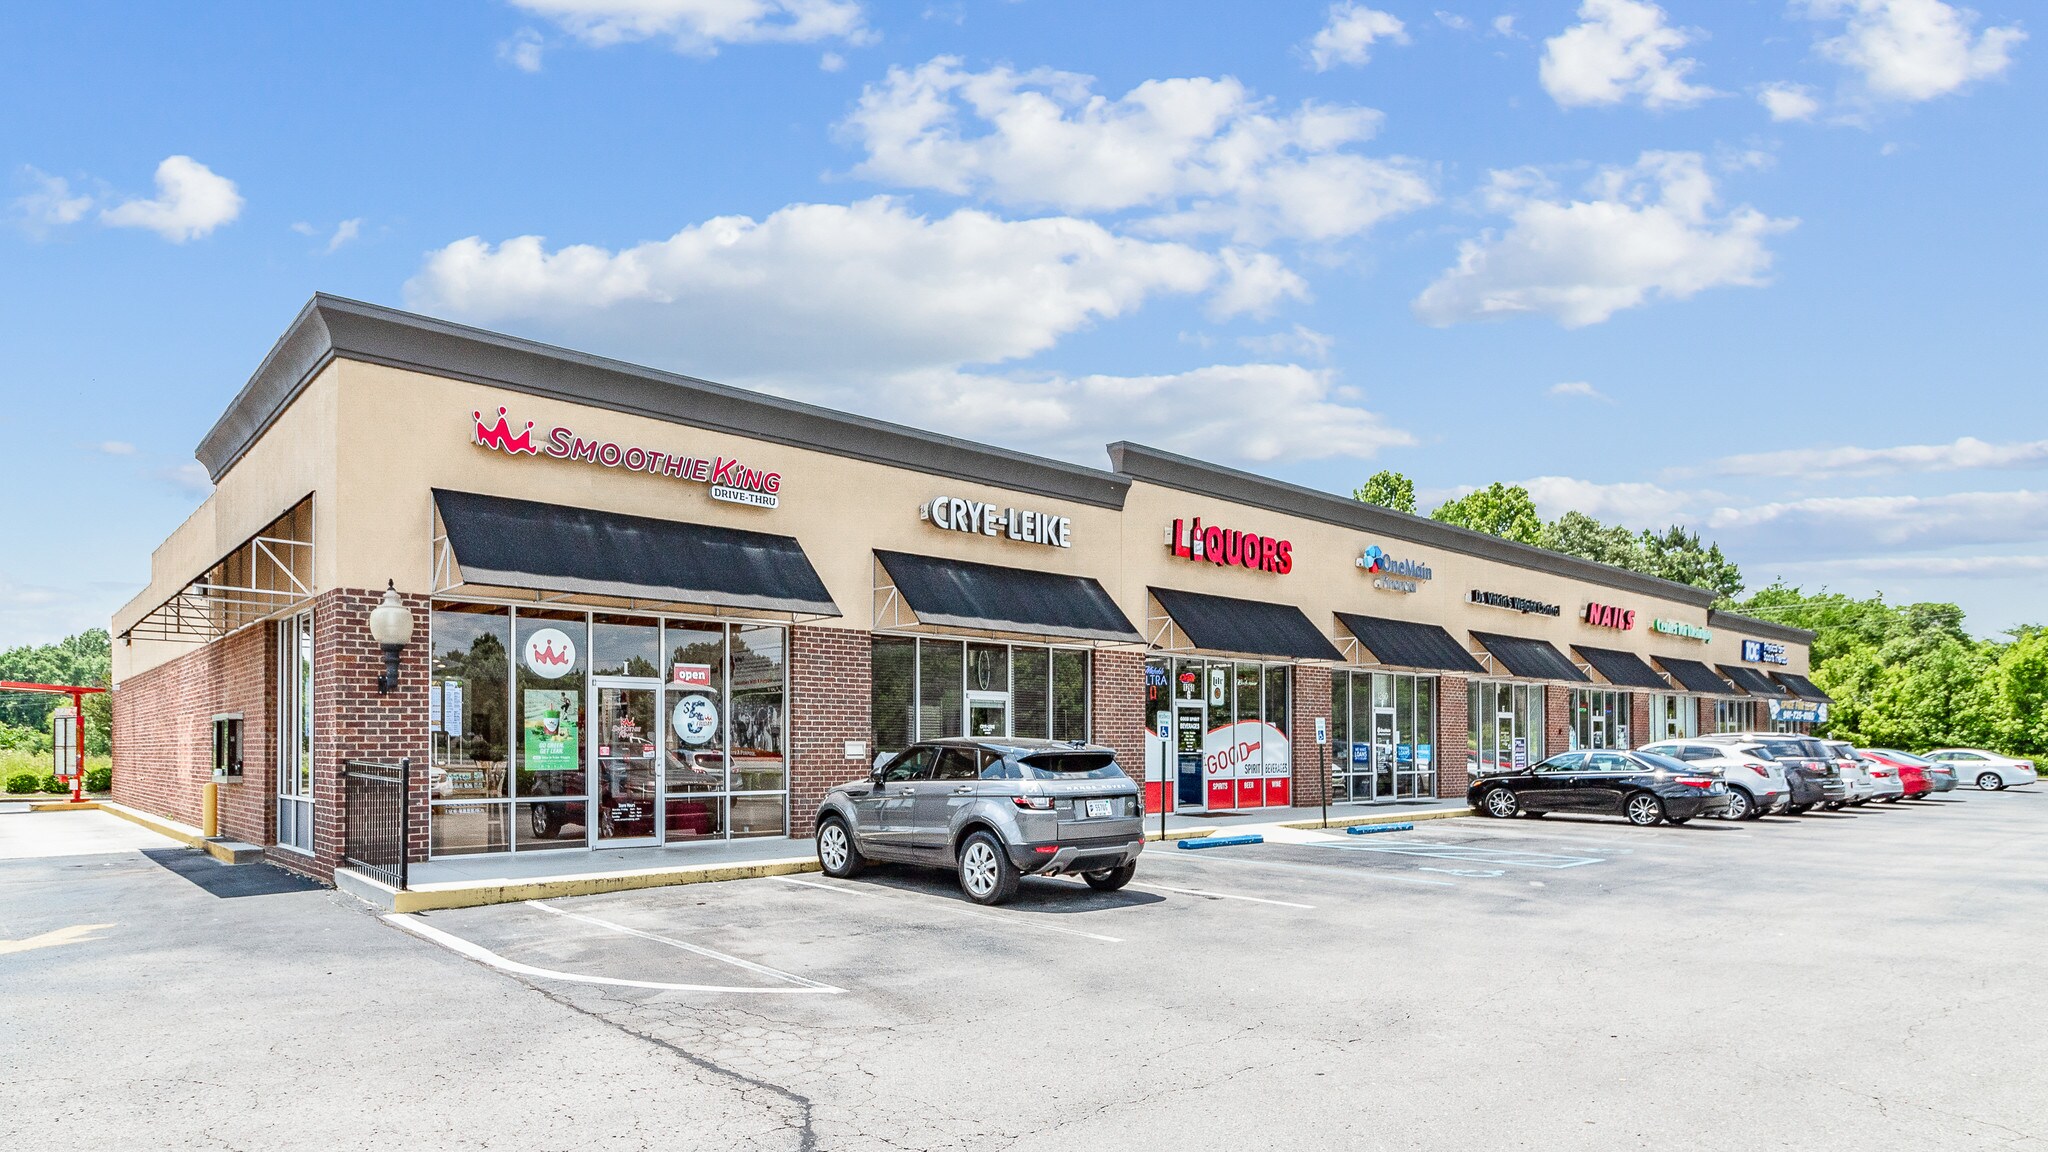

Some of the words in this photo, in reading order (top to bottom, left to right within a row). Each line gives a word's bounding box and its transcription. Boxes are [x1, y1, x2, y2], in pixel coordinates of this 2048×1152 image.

[546, 427, 710, 482] SMOOTHIE
[714, 488, 776, 507] DRIVE-THRU
[931, 495, 1071, 548] CRYE-LEIKE
[1172, 517, 1292, 574] LIQUORS
[1383, 554, 1432, 580] OneMain
[1586, 602, 1636, 631] NAILS
[679, 670, 706, 681] open
[1145, 675, 1167, 686] LTRA
[1207, 741, 1250, 774] GOOD
[1244, 763, 1261, 774] SPIRIT
[1265, 763, 1288, 774] BEVERAGES
[1212, 782, 1228, 790] SPIRITS
[1244, 781, 1254, 789] BEER
